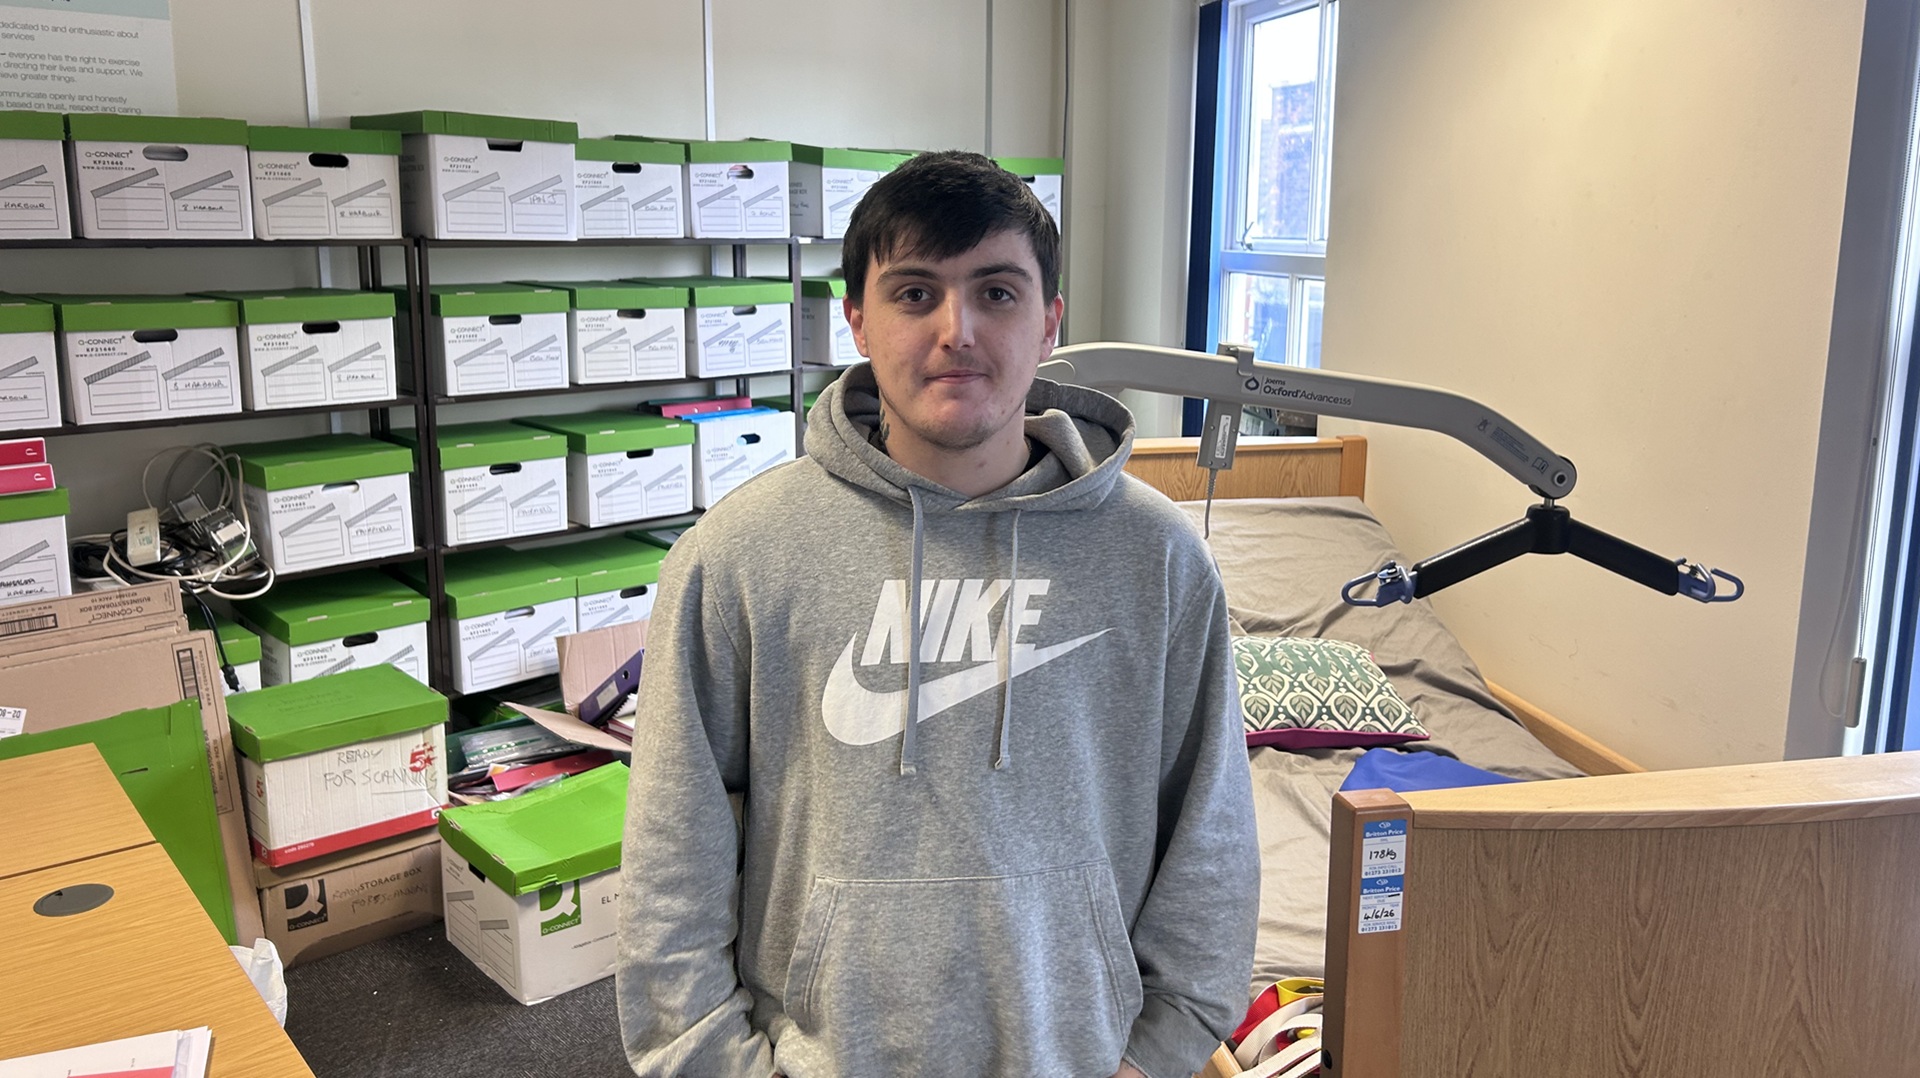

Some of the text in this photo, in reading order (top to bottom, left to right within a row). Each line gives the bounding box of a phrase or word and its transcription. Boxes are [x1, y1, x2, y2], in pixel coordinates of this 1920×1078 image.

[1, 32, 35, 41] services
[69, 27, 114, 37] enthusiastic
[117, 30, 139, 38] about
[8, 51, 45, 61] everyone
[48, 53, 62, 61] has
[65, 54, 77, 62] the
[79, 55, 96, 64] right
[108, 58, 140, 66] exercise
[3, 61, 38, 71] directing
[40, 63, 56, 71] their
[96, 67, 127, 76] support.
[130, 69, 143, 77] We
[21, 73, 48, 81] greater
[51, 75, 77, 83] things.
[49, 93, 76, 102] openly
[95, 95, 127, 104] honestly
[69, 104, 99, 112] respect
[101, 105, 116, 113] and
[93, 600, 122, 610] STORAGE
[123, 596, 151, 606] BUSINESS
[860, 579, 1051, 666] NIKE
[323, 769, 356, 791] FOR
[360, 867, 422, 891] STORAGE BOX
